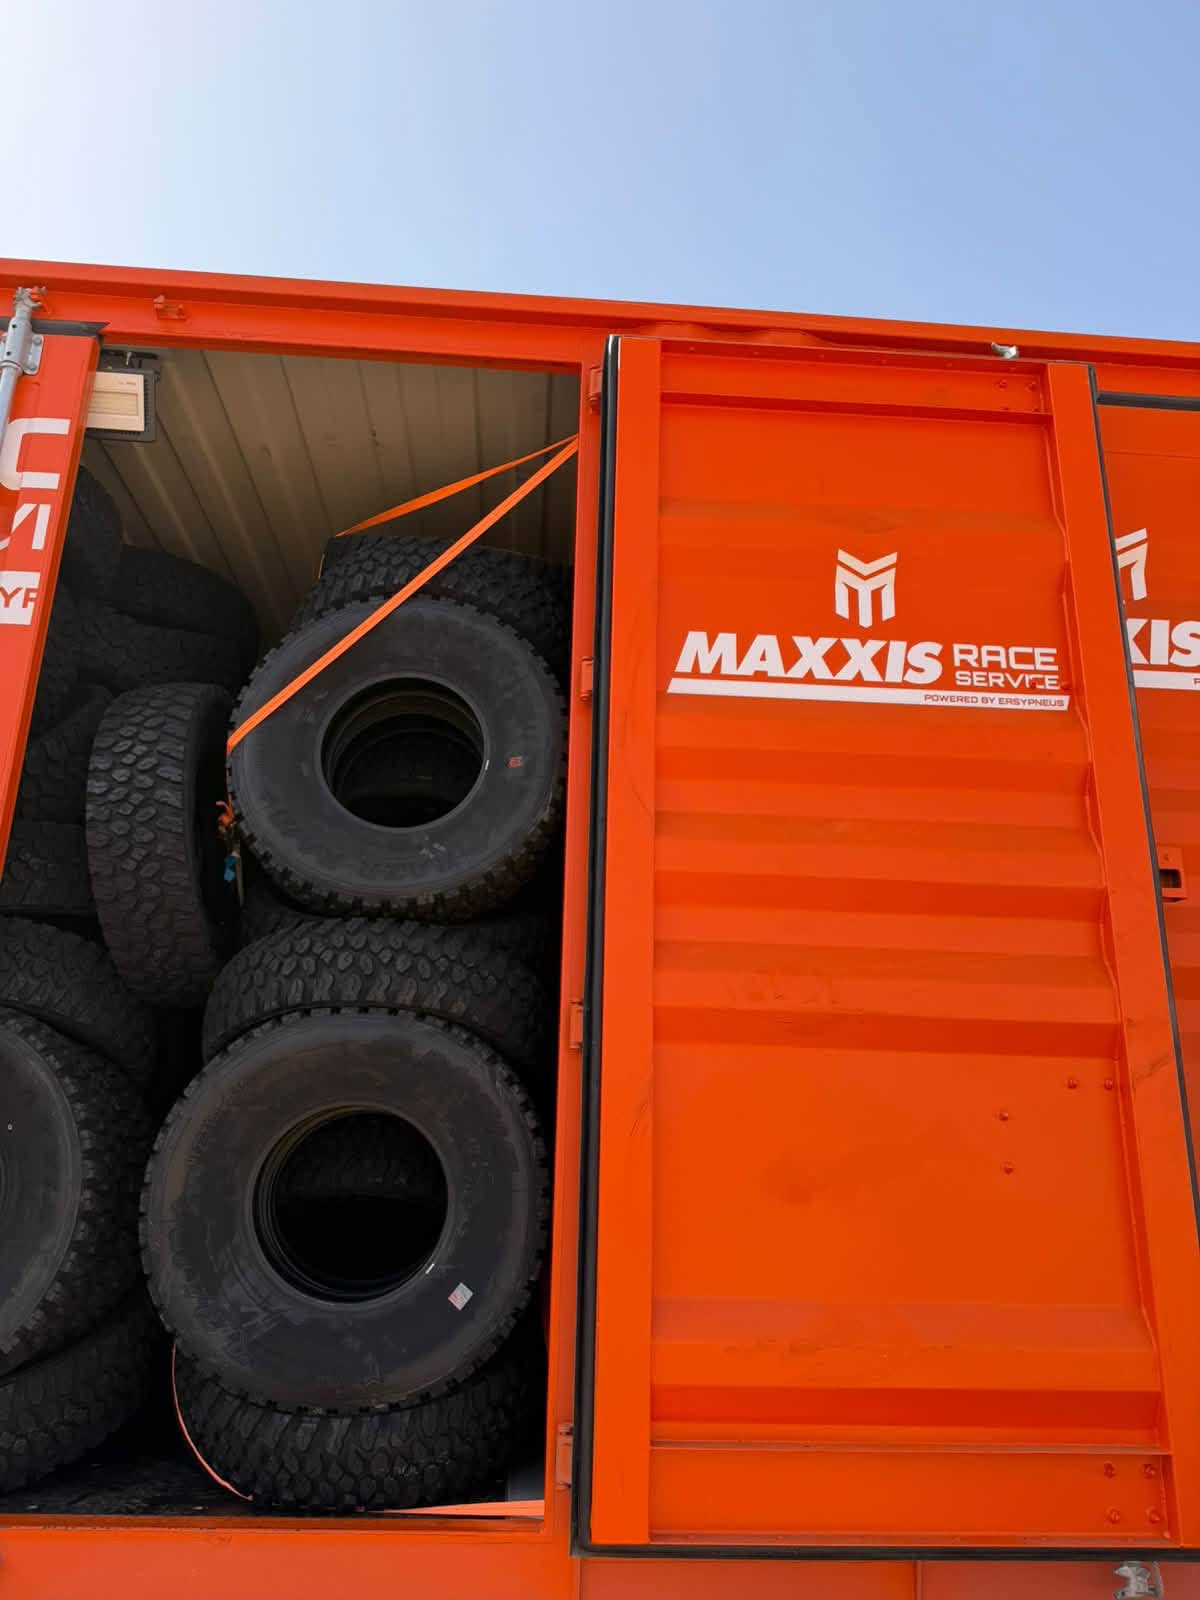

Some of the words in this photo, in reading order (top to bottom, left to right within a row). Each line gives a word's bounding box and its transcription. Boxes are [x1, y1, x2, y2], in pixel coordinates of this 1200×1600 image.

[674, 631, 943, 685] MAXXIS
[953, 643, 1059, 671] RACE
[955, 670, 1060, 690] SERVICE
[924, 694, 978, 704] POWERED
[981, 696, 996, 704] BY
